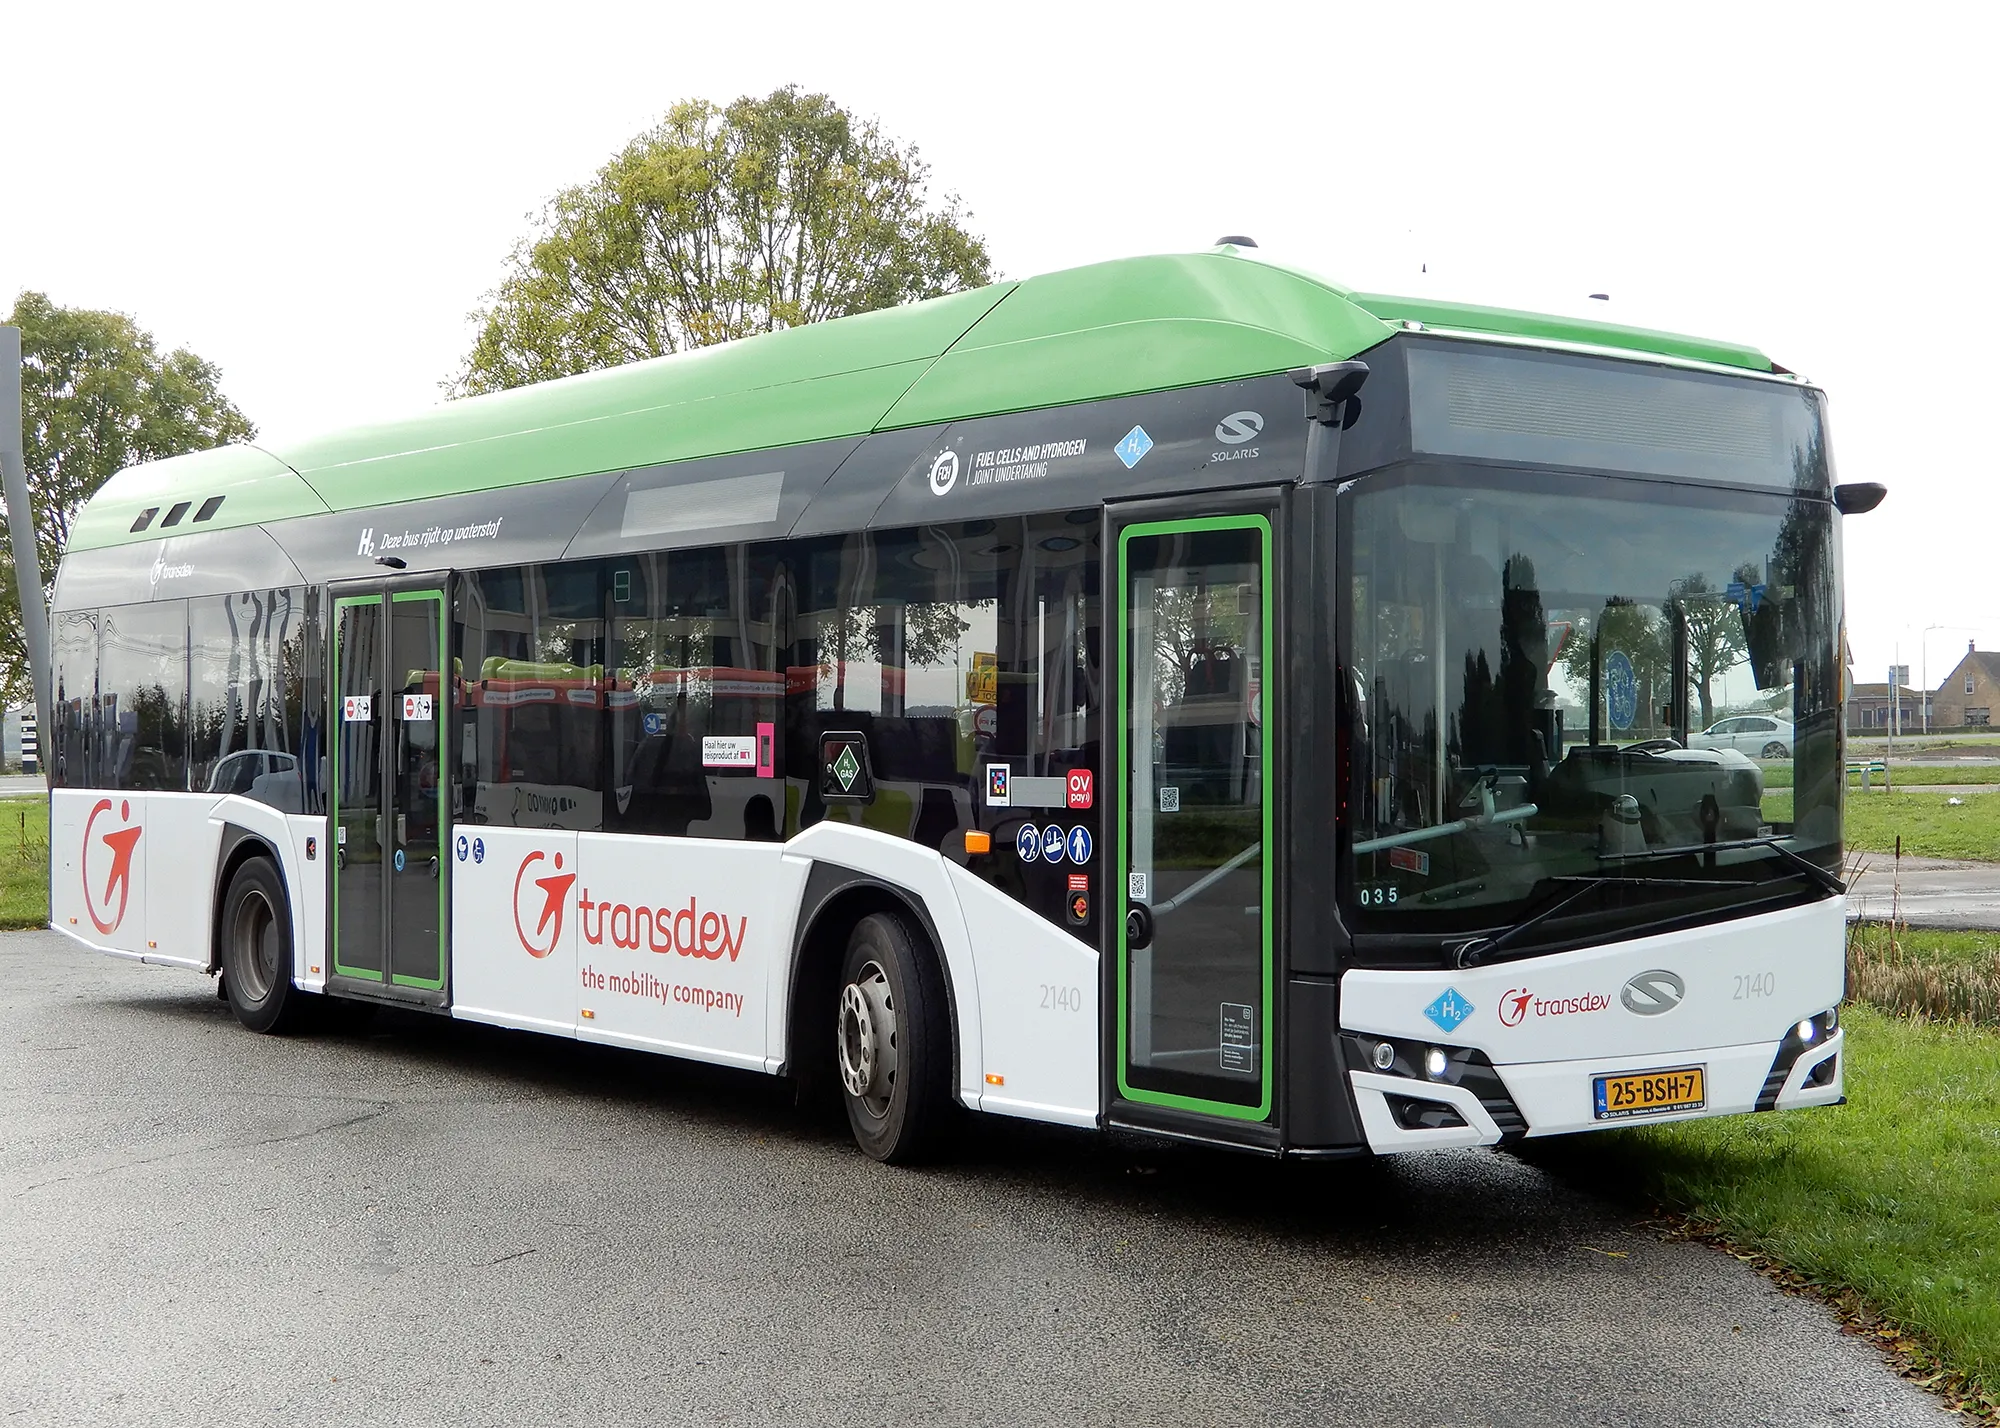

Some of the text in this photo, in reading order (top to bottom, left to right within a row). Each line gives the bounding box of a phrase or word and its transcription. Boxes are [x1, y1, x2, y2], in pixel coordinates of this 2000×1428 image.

[976, 439, 1087, 467] FUEL CELLS AND HYDROGEN
[1211, 448, 1260, 463] SOLARIS
[937, 465, 951, 481] FCH
[972, 462, 1048, 486] JOINT UNDERTAKING
[380, 517, 503, 549] Deze bus rijdt op waterstof
[163, 562, 196, 579] transdev
[704, 740, 716, 749] Haal
[717, 740, 727, 749] hier
[704, 751, 739, 760] reisproduct af
[840, 769, 853, 779] GAS
[1070, 775, 1090, 792] OV
[1071, 793, 1085, 803] pay
[579, 888, 748, 962] transdev
[582, 965, 743, 1017] the mobility company
[1733, 972, 1775, 1000] 2140
[1040, 984, 1081, 1013] 2140
[1535, 992, 1611, 1017] transdev
[1612, 1075, 1695, 1106] 25-BSH-7
[1598, 1098, 1606, 1107] NL
